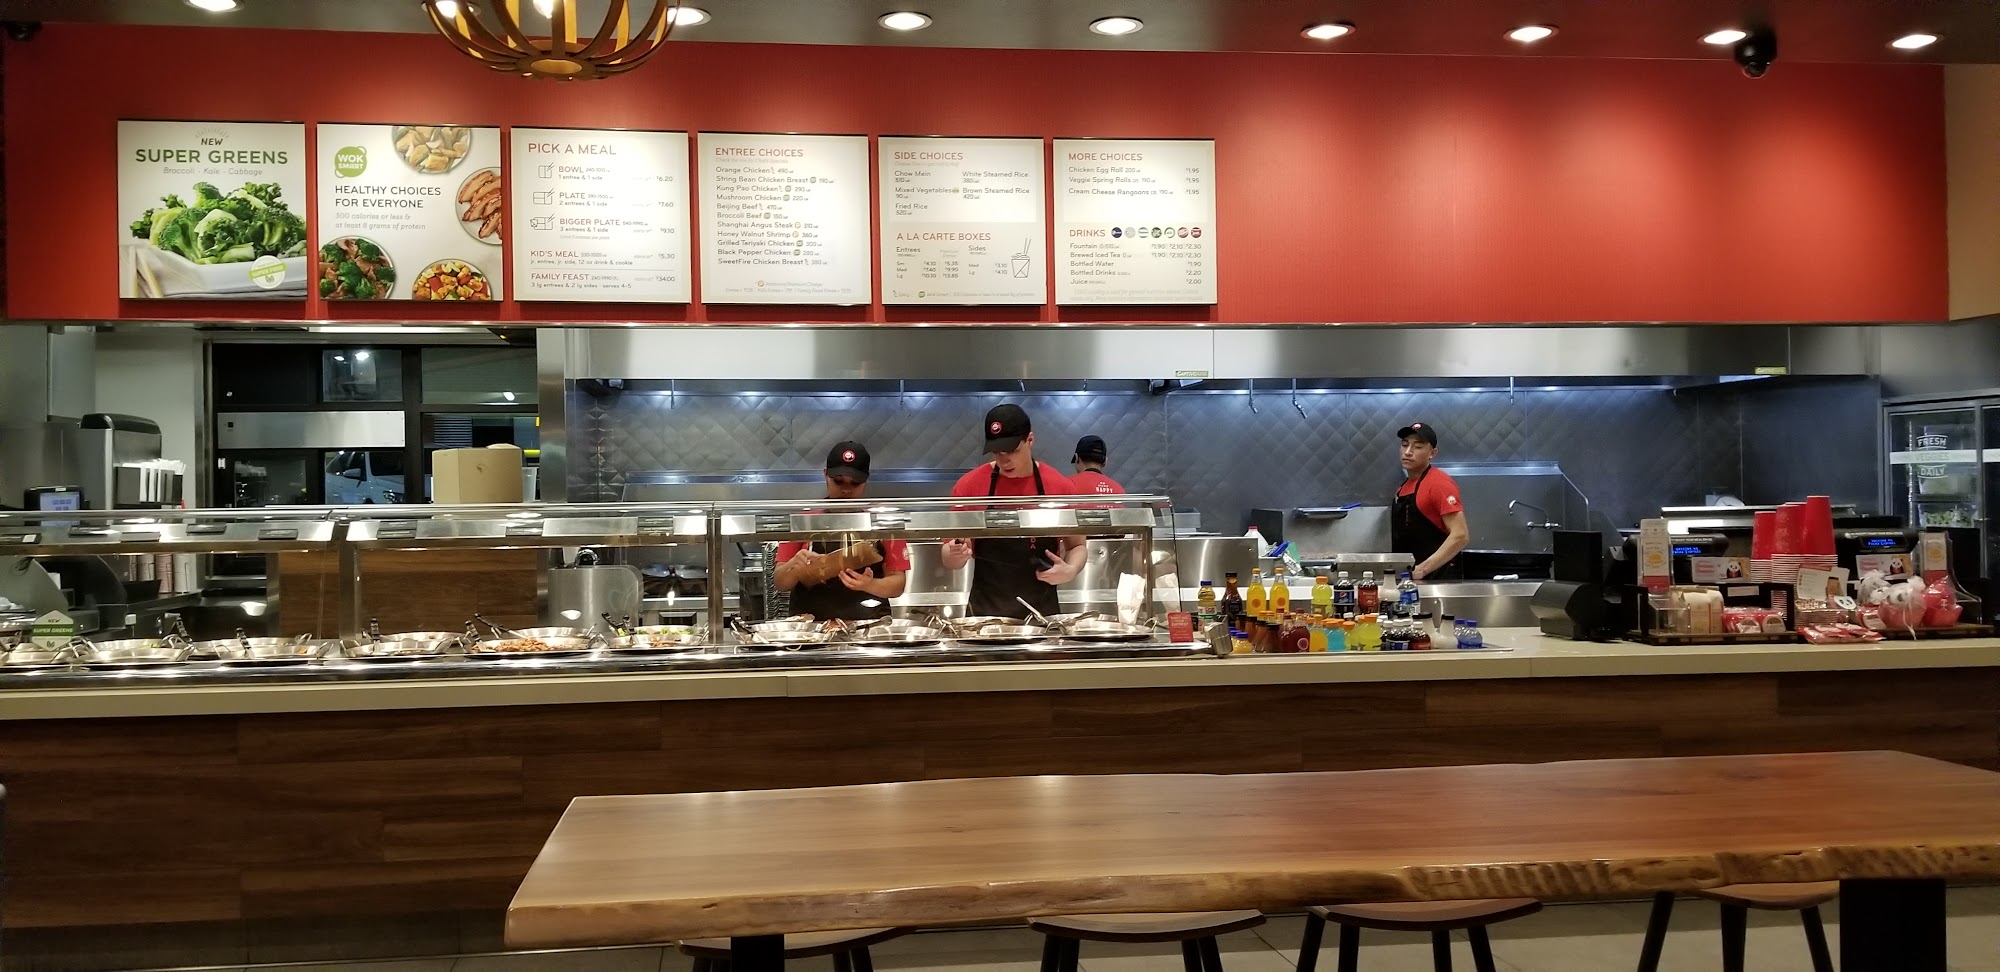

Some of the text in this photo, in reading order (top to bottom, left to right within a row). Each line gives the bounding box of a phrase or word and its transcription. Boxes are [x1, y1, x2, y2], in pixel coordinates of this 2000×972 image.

[201, 138, 223, 146] NEW
[528, 143, 616, 155] PICK A MEAL
[715, 148, 803, 157] ENTREE CHOICES
[135, 149, 288, 164] SUPER GREENS
[338, 155, 363, 163] WOK
[894, 151, 963, 160] SIDE CHOICES
[1069, 153, 1143, 161] MORE CHOICES
[163, 167, 194, 175] Broccoli
[228, 168, 263, 176] Cabbage
[335, 185, 441, 195] HEALTHY CHOICES
[916, 187, 952, 195] Vegetables
[335, 198, 424, 208] FOR EVERYONE
[717, 203, 740, 211] Beijing
[717, 221, 749, 229] Shanghai
[717, 231, 739, 239] Honey
[766, 231, 791, 239] Shrimp
[897, 233, 991, 241] A LA CARTE BOXES
[1069, 229, 1106, 237] DRINKS
[742, 240, 766, 248] Teriyaki
[738, 249, 762, 257] Pepper
[531, 273, 560, 281] FAMILY
[1918, 438, 1946, 446] FRESH
[1921, 468, 1945, 476] DAILY
